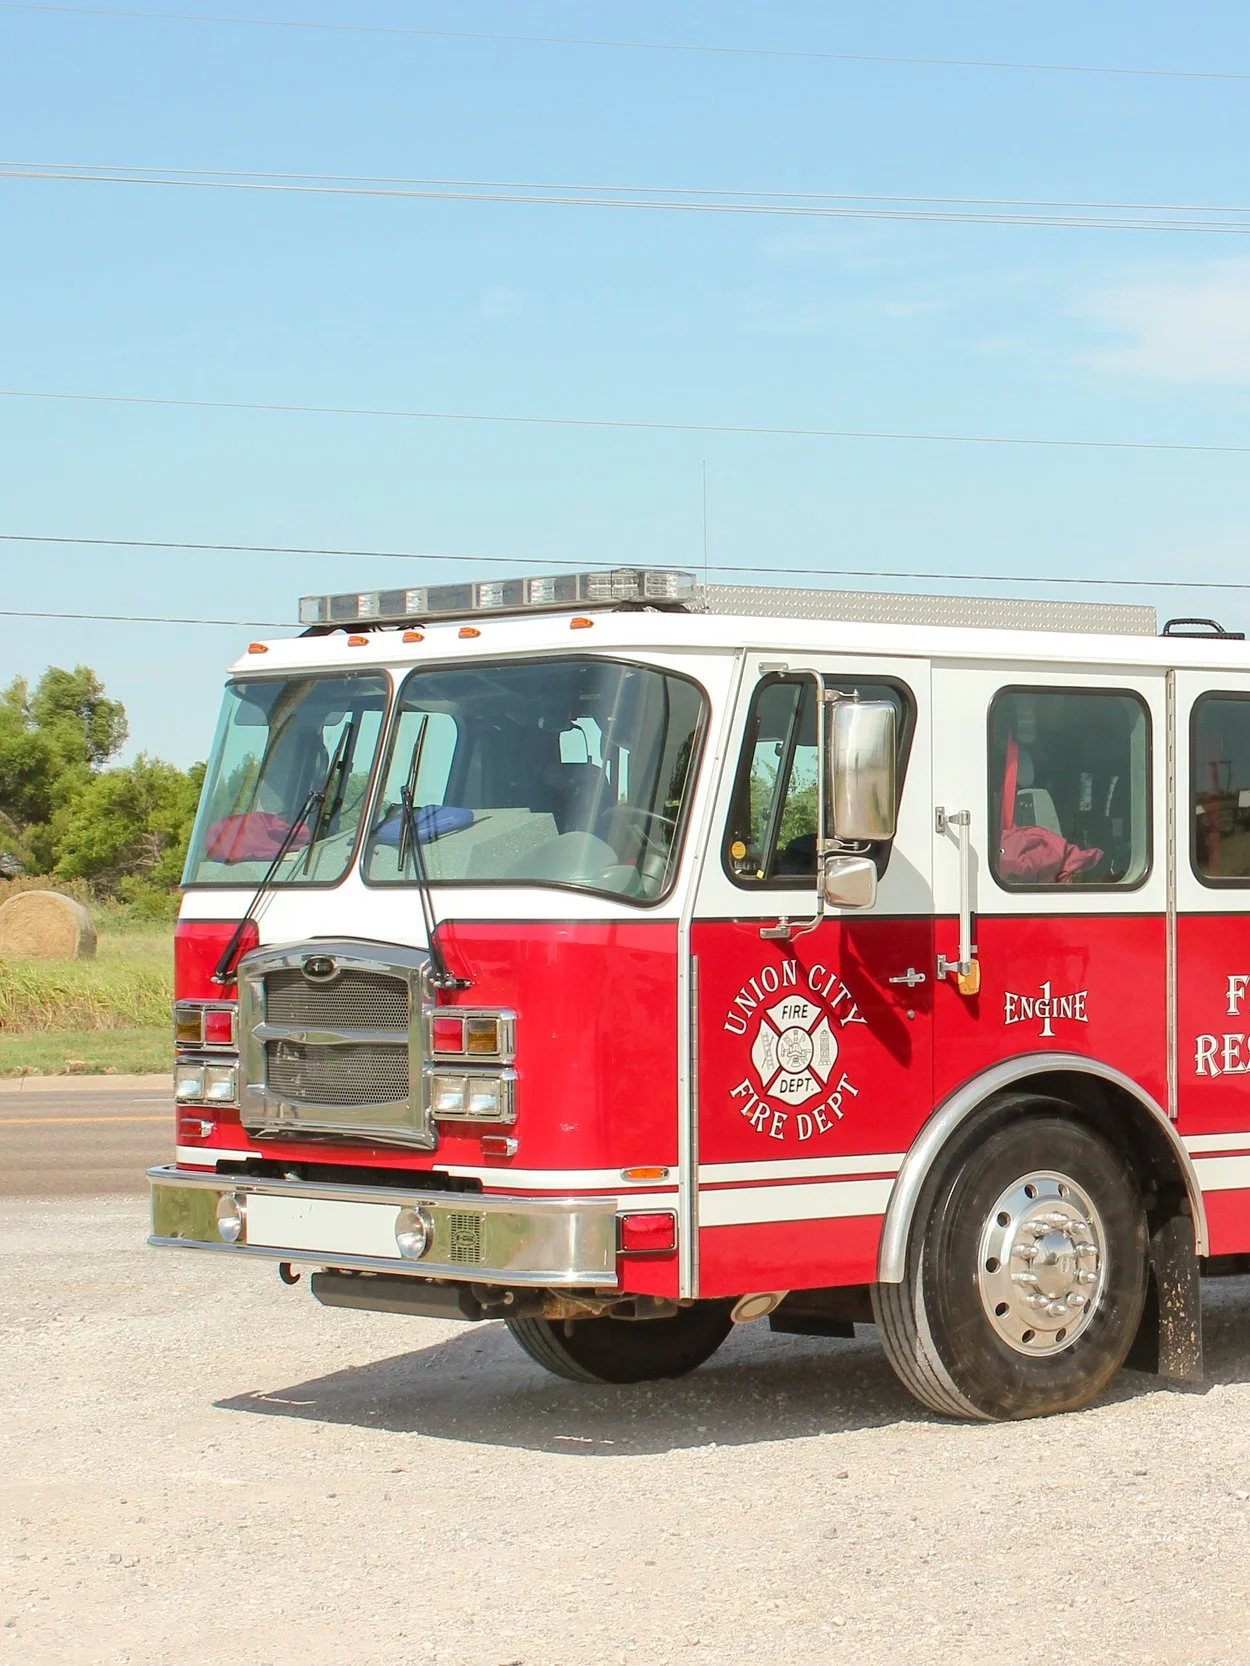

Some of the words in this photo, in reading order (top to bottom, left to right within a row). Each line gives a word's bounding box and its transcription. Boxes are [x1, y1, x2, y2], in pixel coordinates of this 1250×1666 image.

[724, 959, 797, 1035] UNION
[808, 964, 867, 1028] CITY
[781, 1004, 808, 1019] FIRE
[1003, 990, 1089, 1026] ENGINE
[1038, 980, 1056, 1037] 1
[730, 1078, 788, 1139] FIRE
[796, 1073, 859, 1141] DEPT
[779, 1077, 814, 1093] DEPT.
